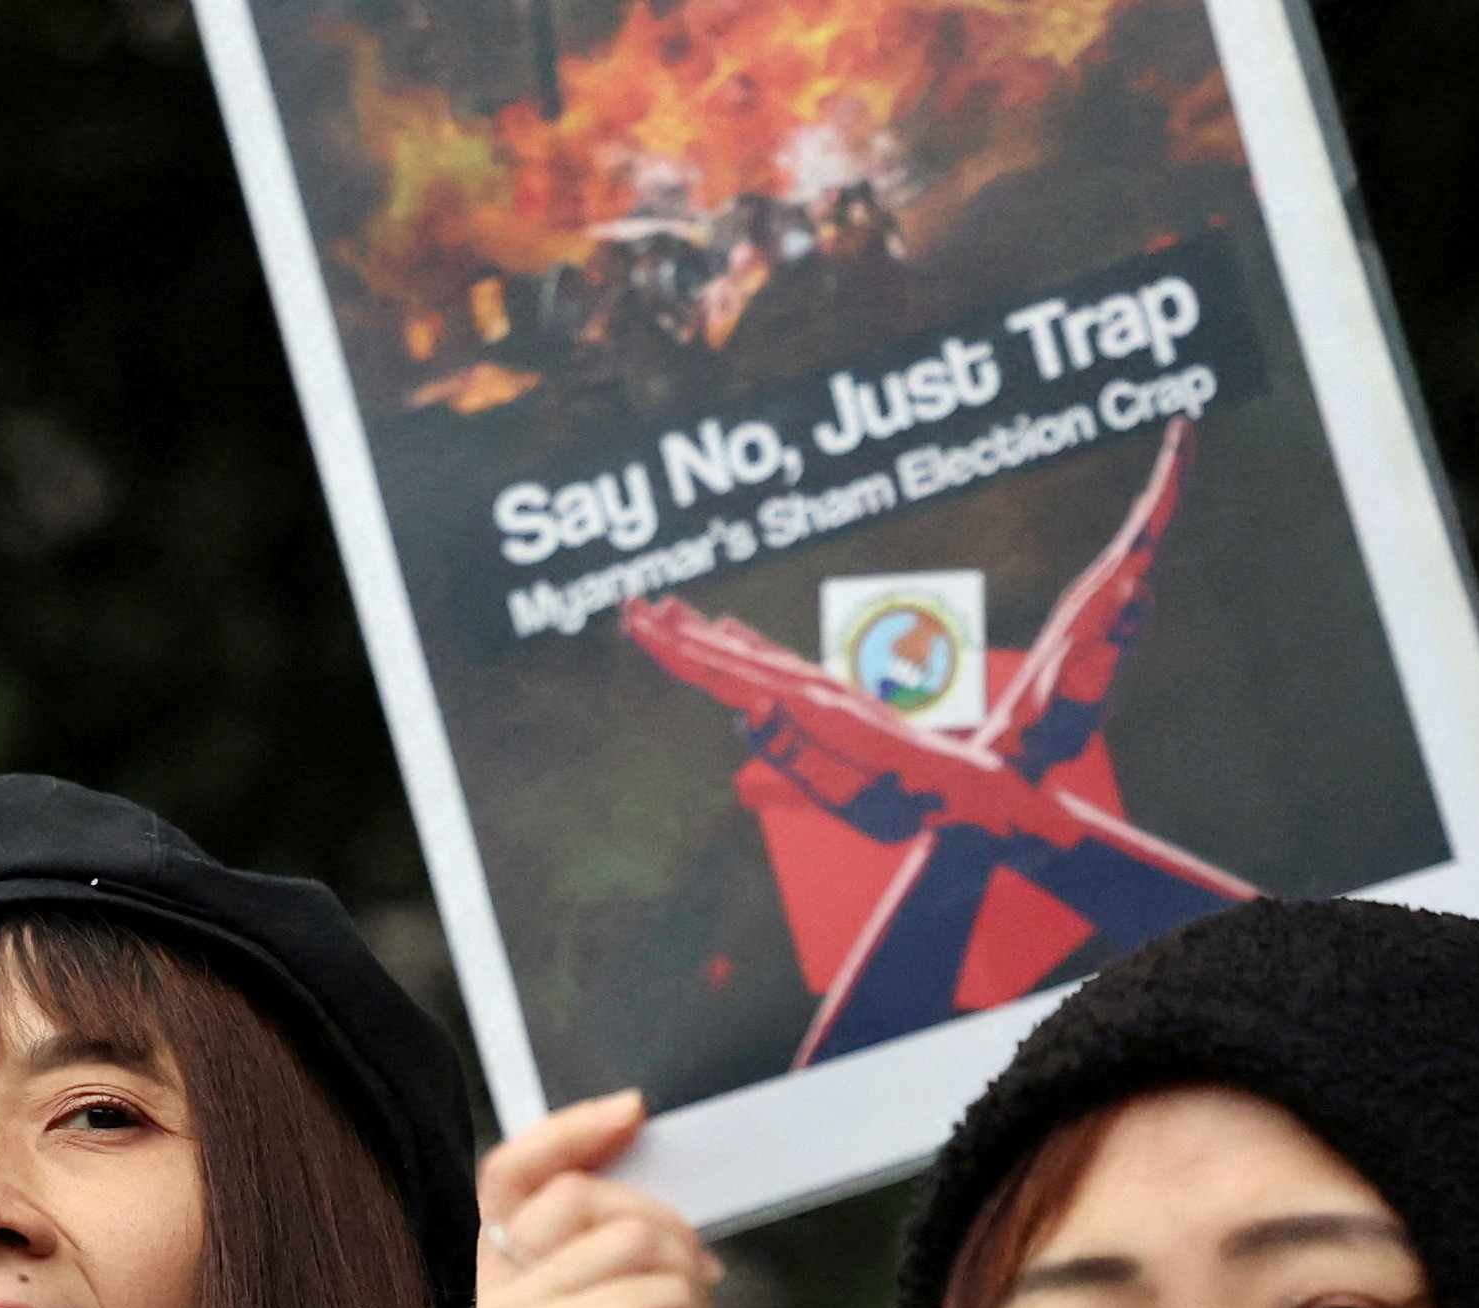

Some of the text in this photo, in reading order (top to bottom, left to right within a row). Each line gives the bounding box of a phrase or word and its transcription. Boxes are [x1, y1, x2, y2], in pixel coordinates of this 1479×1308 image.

[493, 275, 1200, 564] Say No, Just Trap
[509, 364, 1218, 636] Myanmar's Sham Election Crap
